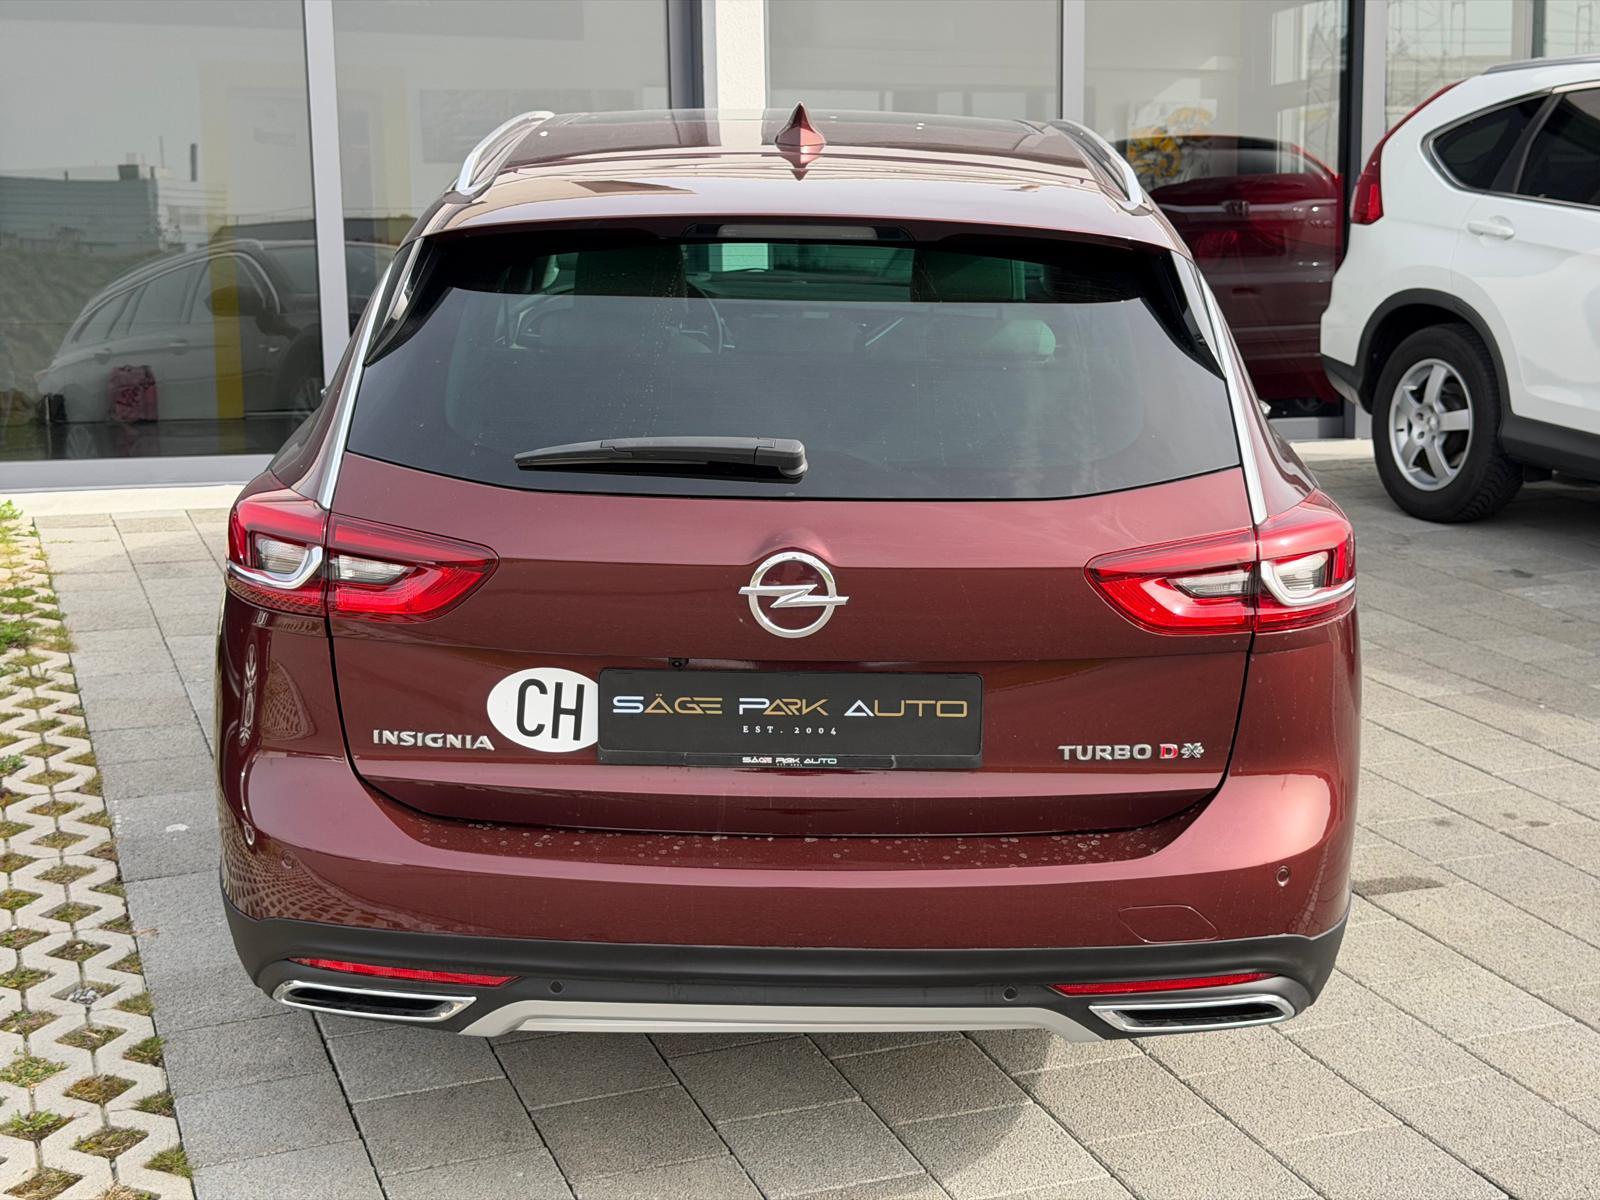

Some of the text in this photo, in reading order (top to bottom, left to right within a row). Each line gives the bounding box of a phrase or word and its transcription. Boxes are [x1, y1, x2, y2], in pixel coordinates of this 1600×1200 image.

[516, 678, 585, 741] CH
[612, 692, 968, 718] SÄGE PARK AUTO
[372, 729, 496, 751] INSIGNIA
[742, 725, 837, 736] EST. 2004
[1057, 743, 1152, 761] TURBO
